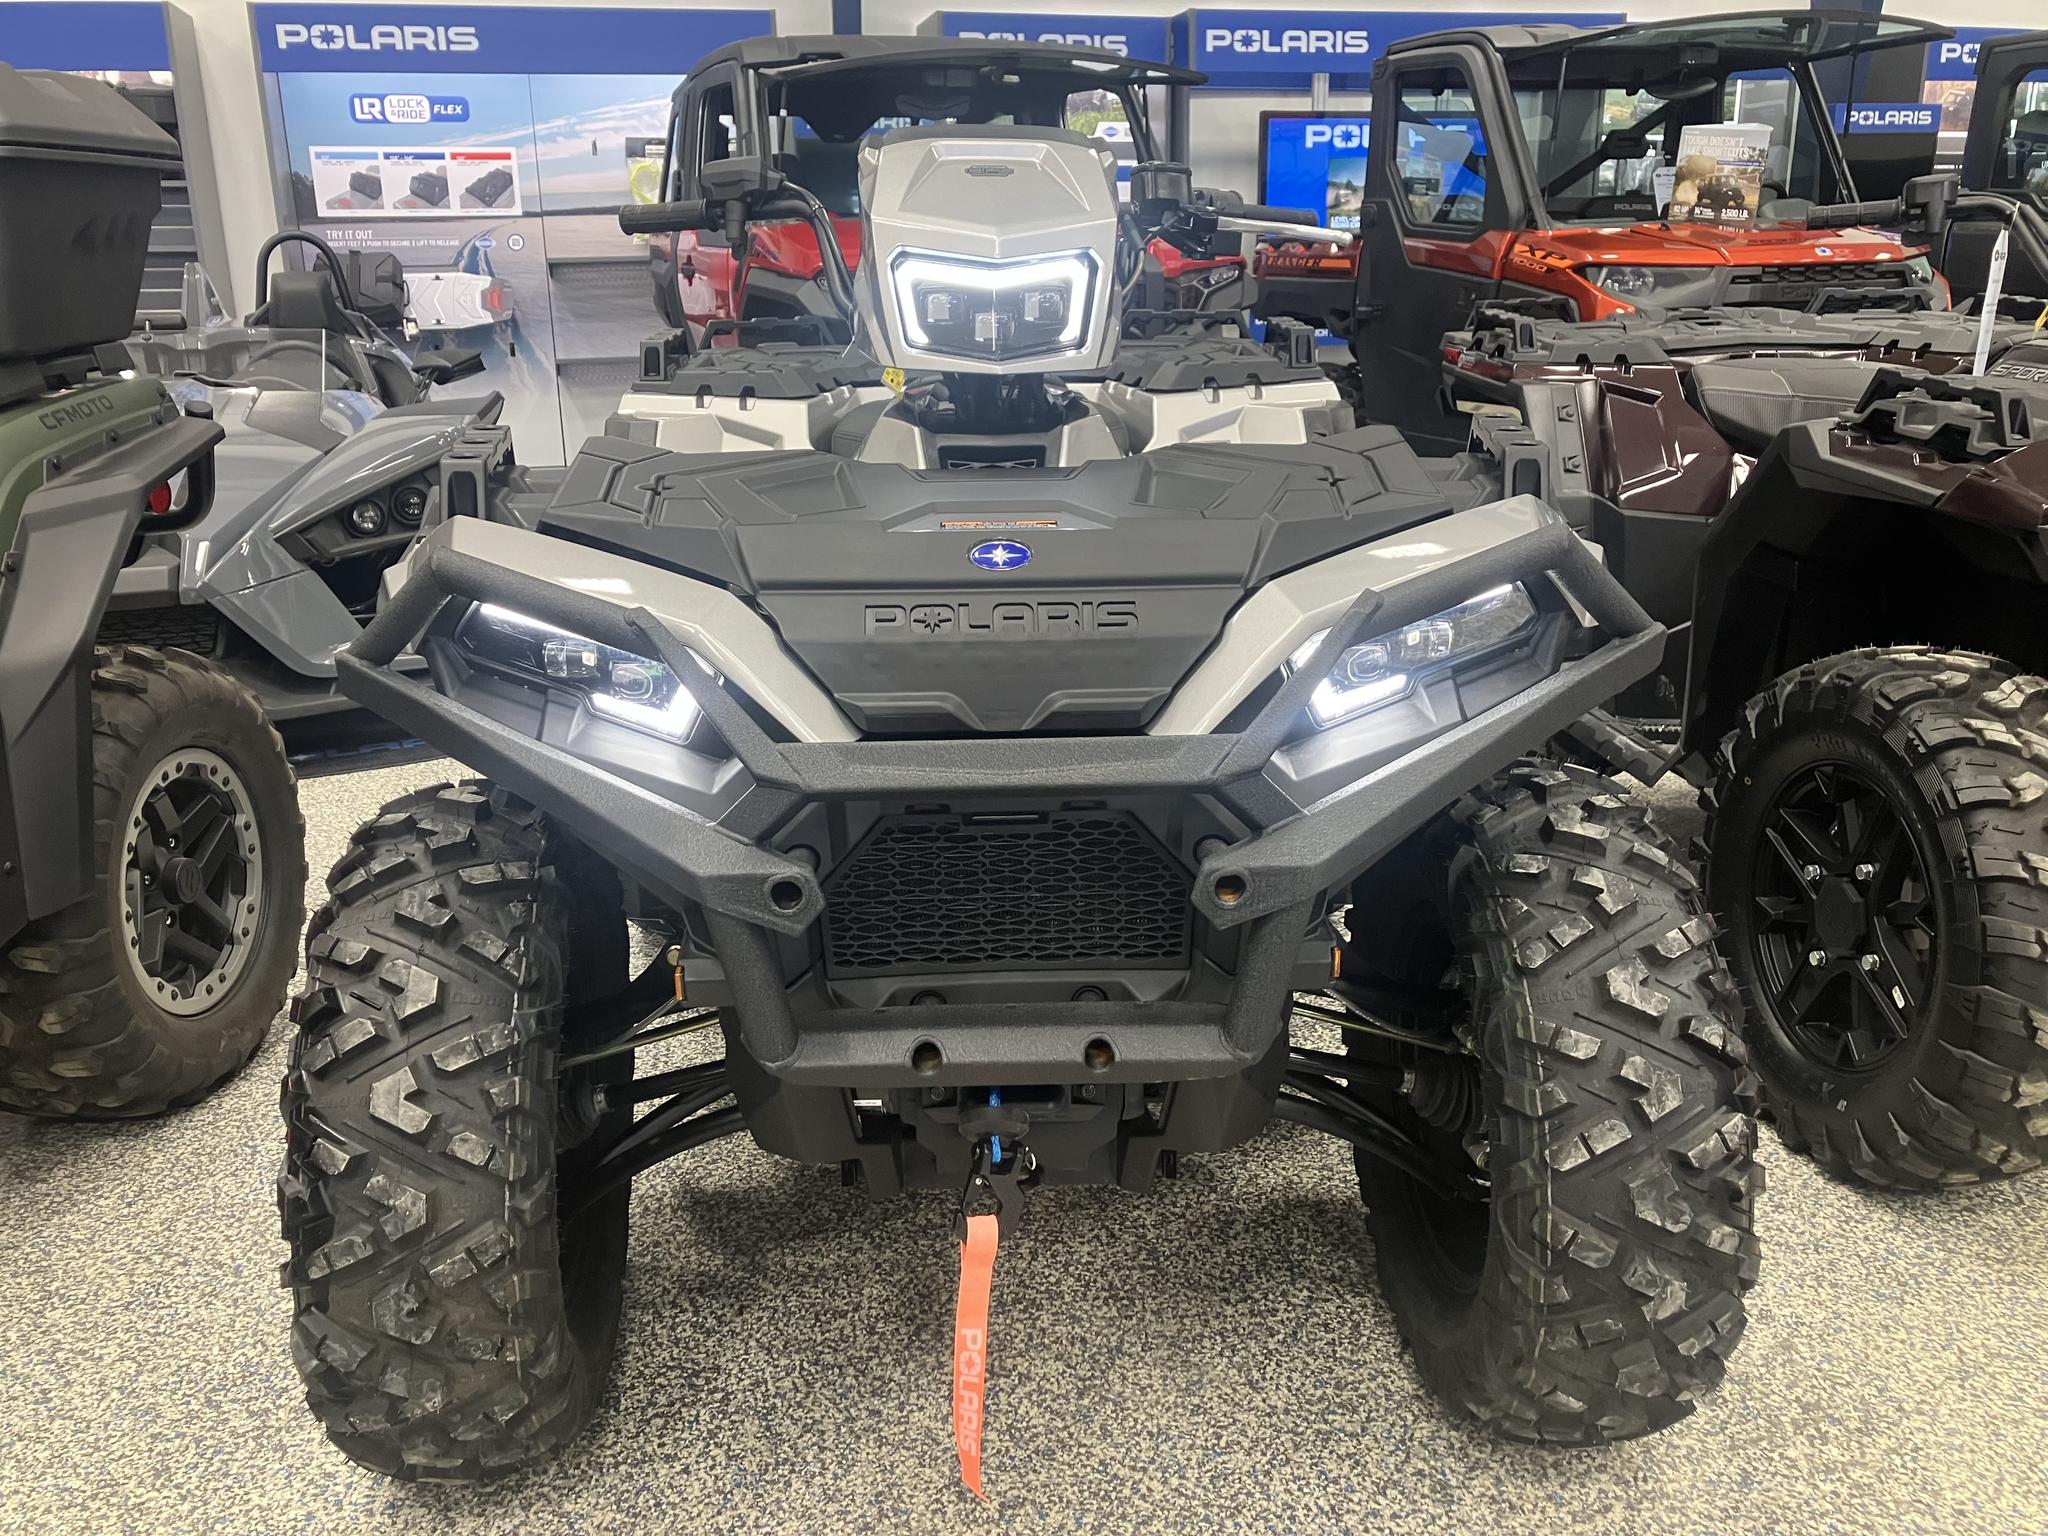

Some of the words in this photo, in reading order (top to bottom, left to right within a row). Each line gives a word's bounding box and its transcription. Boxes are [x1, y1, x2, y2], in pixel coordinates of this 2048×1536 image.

[275, 23, 480, 51] POLARIS
[1205, 29, 1370, 54] POLARIS
[389, 98, 425, 109] LOCK
[432, 104, 463, 115] FLEX
[1684, 135, 1709, 146] TOUGH
[326, 230, 343, 240] TRY
[345, 230, 353, 240] IT
[355, 230, 373, 240] OUT
[1512, 257, 1548, 273] 1000
[1990, 363, 2048, 382] SPOR
[38, 394, 114, 430] CFMOTO
[864, 600, 1139, 636] POLARIS
[959, 1327, 983, 1458] POLARIS
